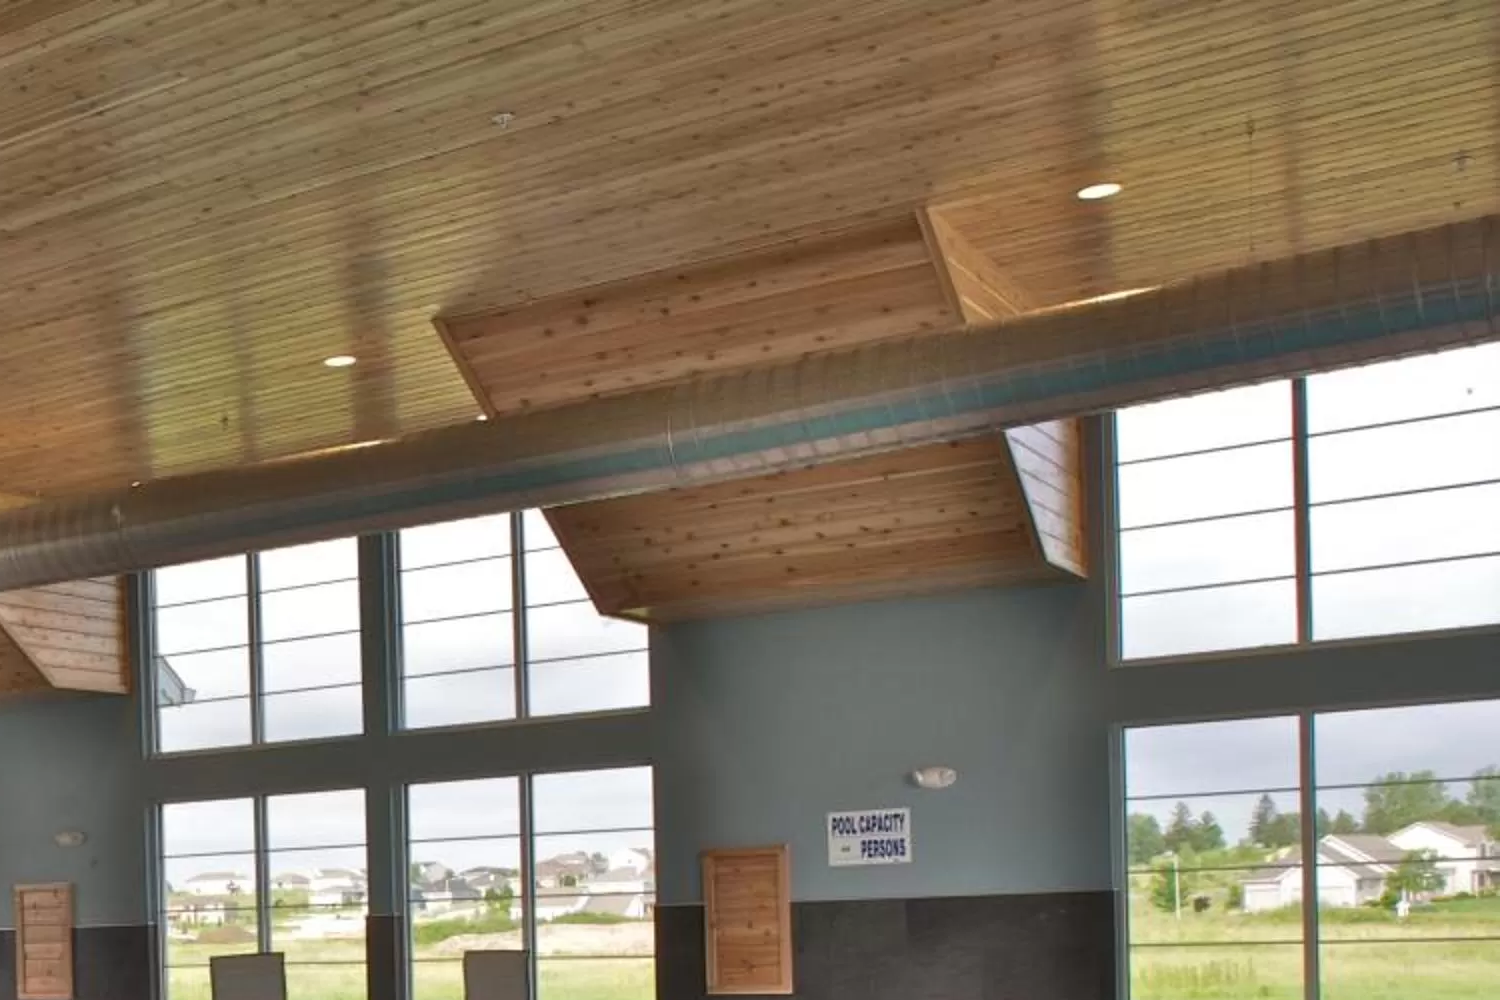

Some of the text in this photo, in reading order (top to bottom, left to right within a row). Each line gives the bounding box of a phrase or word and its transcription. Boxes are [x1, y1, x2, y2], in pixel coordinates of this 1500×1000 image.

[832, 813, 905, 836] POOL CAPACITY
[861, 838, 905, 858] PERSONS
